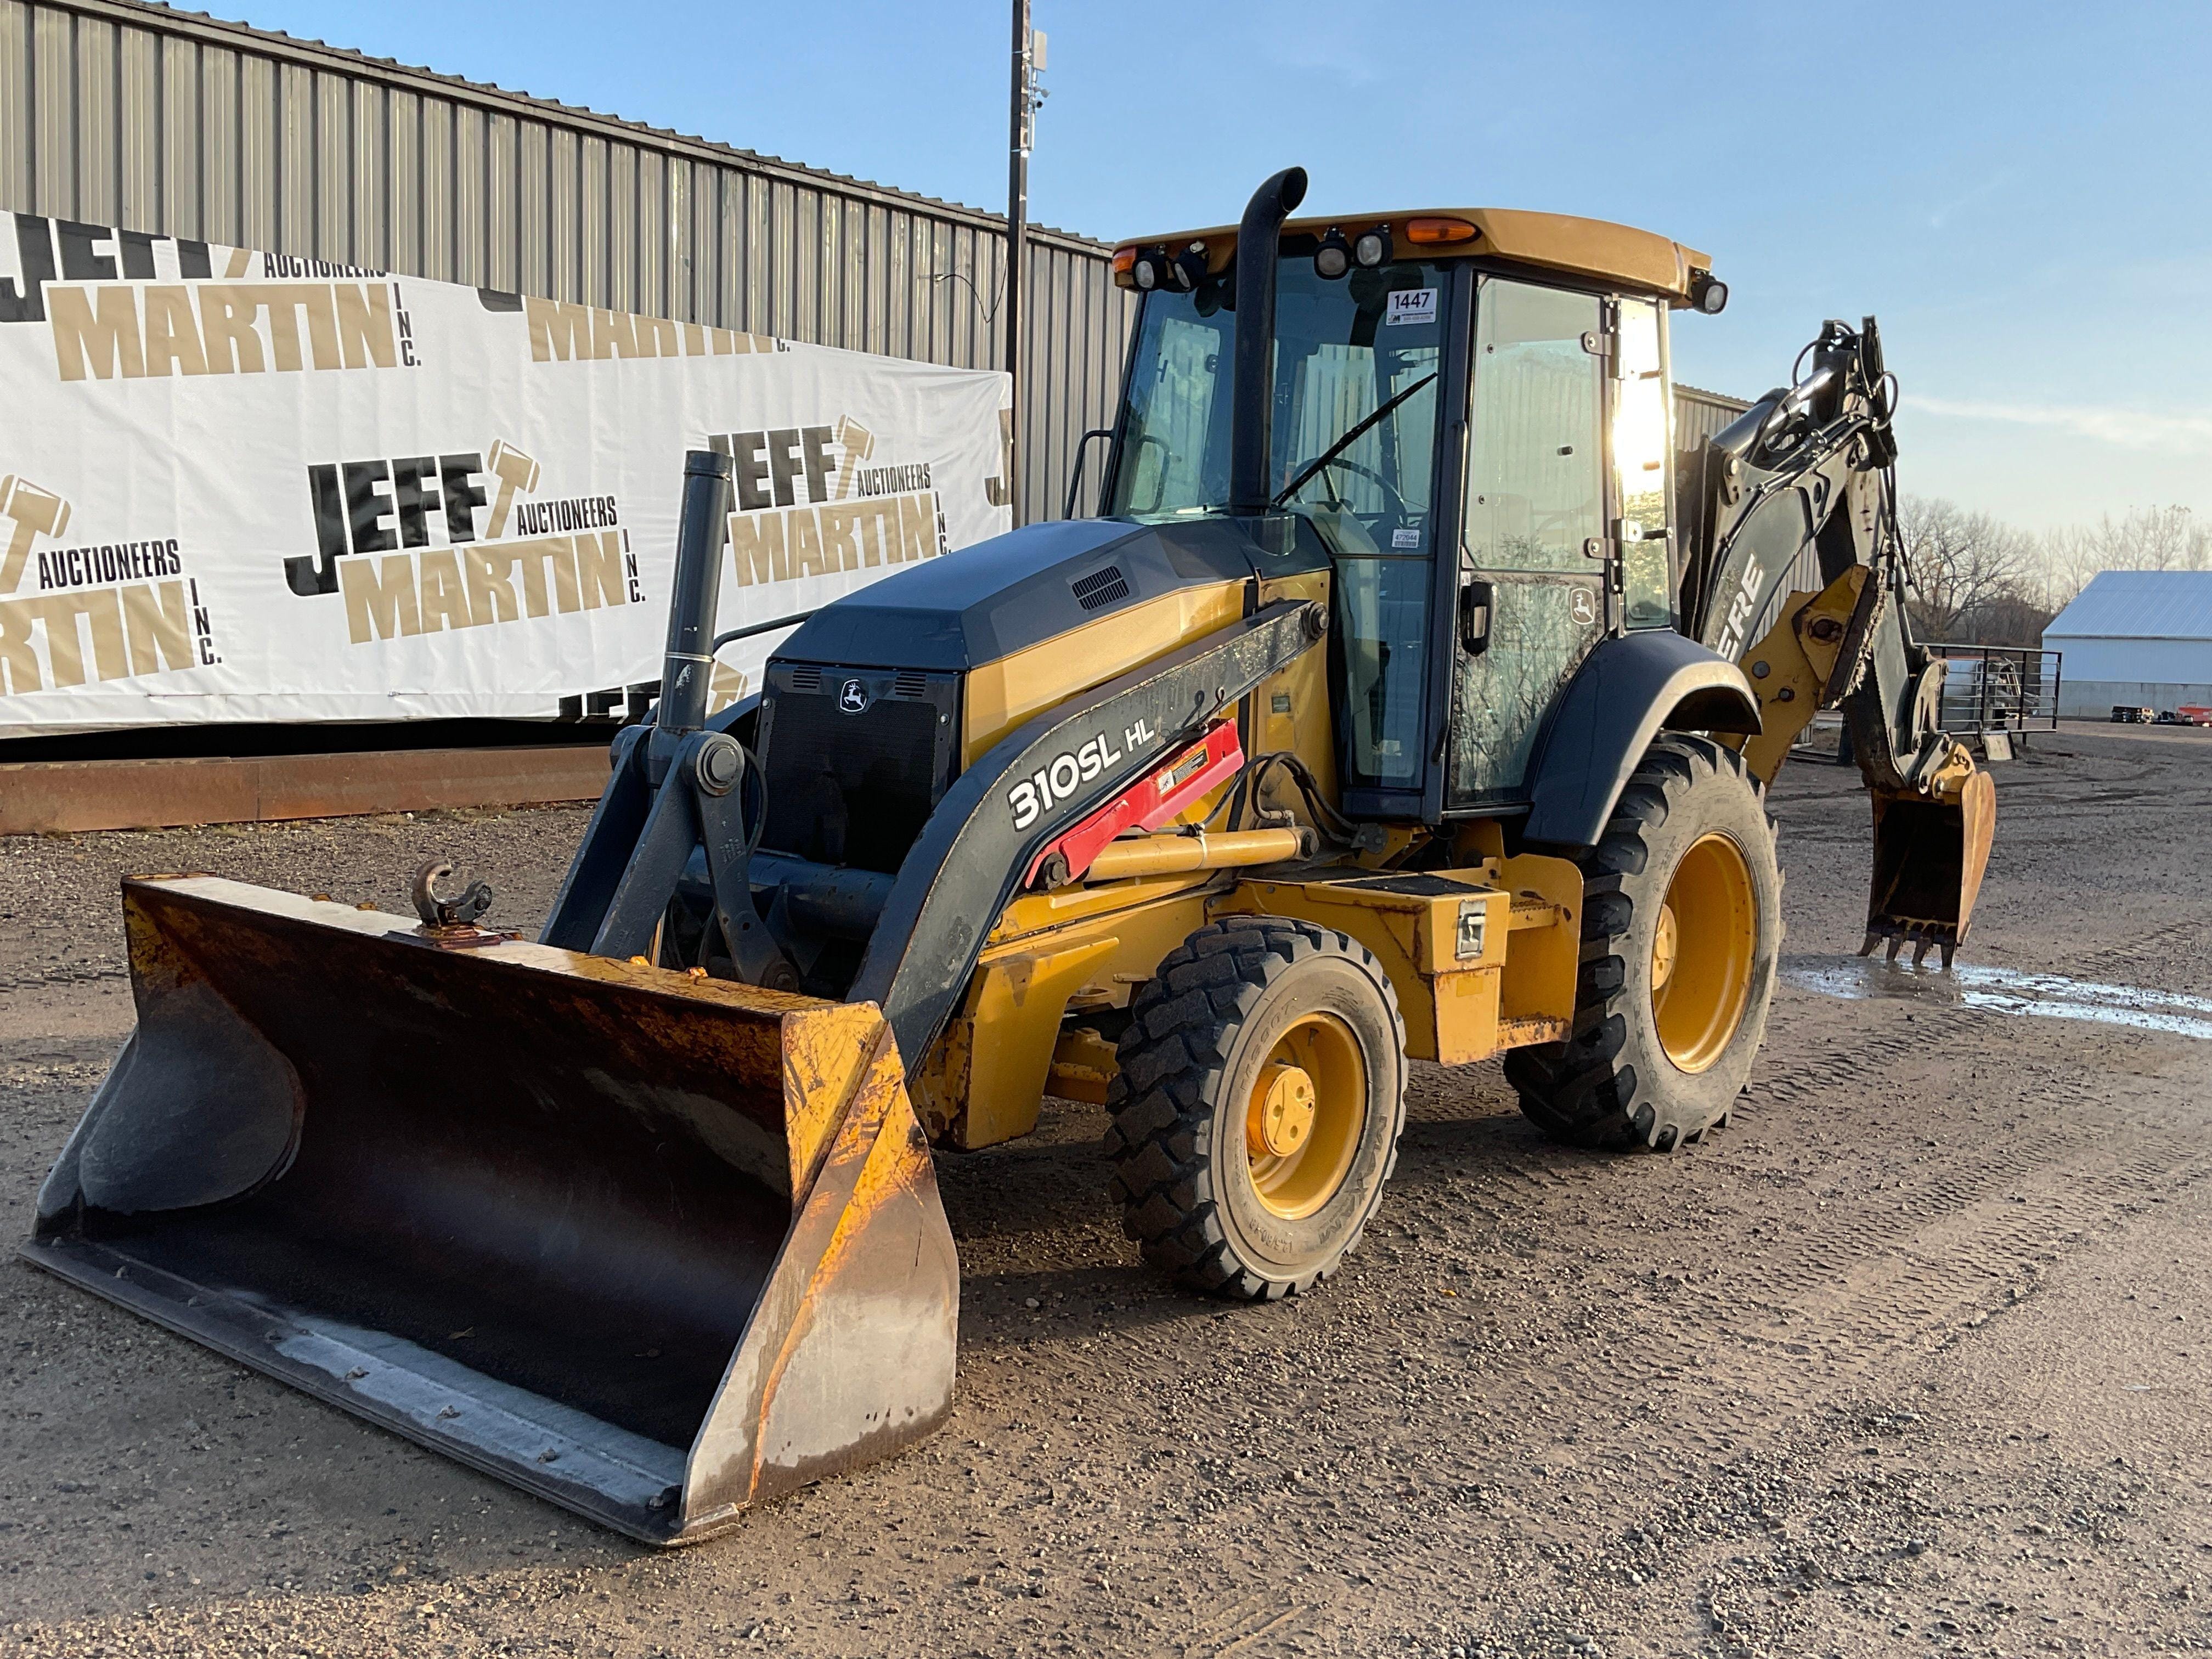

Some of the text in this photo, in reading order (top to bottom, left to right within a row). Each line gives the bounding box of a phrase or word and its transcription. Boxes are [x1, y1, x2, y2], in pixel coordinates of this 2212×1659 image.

[47, 283, 398, 381] MARTIN
[393, 283, 421, 367] INC.
[1394, 292, 1430, 309] 1447
[517, 495, 618, 536] AUCTIONEERS
[857, 462, 931, 497] AUCTIONEERS
[38, 539, 181, 590] AUCTIONEERS
[284, 453, 487, 597] JEFF
[623, 528, 646, 603] INC.
[730, 493, 936, 588] MARTIN
[189, 578, 222, 665] INC.
[340, 530, 626, 644] MARTIN
[1008, 733, 1122, 830] 310SL
[1125, 718, 1155, 752] HL
